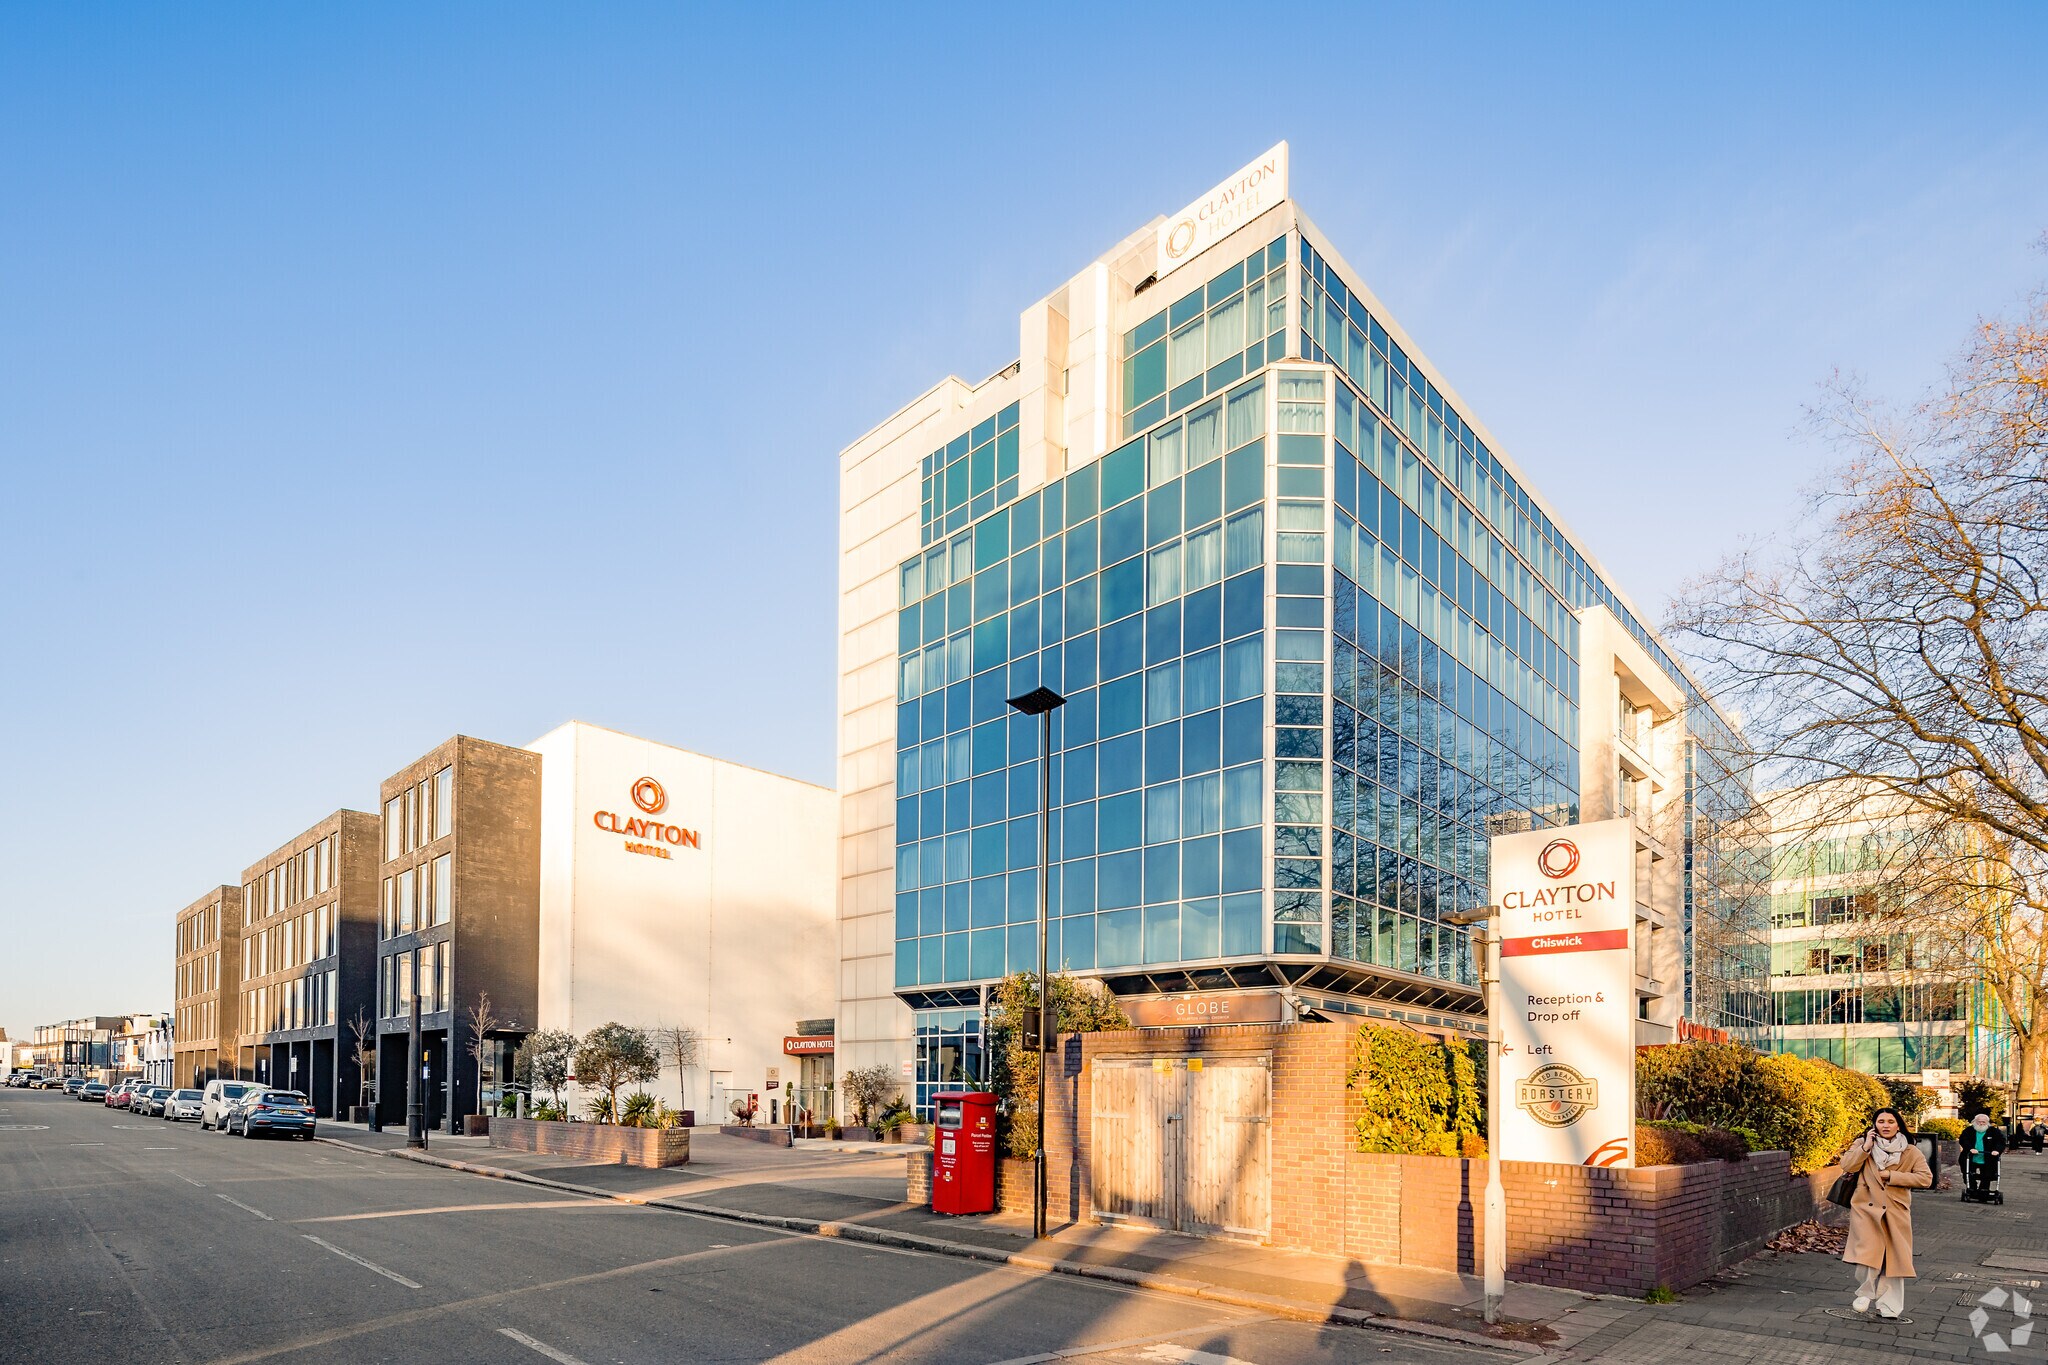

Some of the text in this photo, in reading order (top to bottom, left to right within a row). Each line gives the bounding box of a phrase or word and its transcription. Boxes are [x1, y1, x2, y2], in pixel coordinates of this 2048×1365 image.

[1198, 159, 1275, 221] CLAYTON
[1208, 191, 1262, 236] HOTEL
[593, 810, 698, 848] CLAYTON
[624, 840, 671, 859] HOTEL
[1502, 881, 1615, 910] CLAYTON
[1533, 909, 1582, 922] HOTEL
[1531, 936, 1582, 949] Chiswick
[1527, 991, 1605, 1007] Reception &
[1176, 1001, 1230, 1015] GLOBE
[1527, 1010, 1580, 1023] Drop off
[793, 1040, 834, 1049] CLAYTON HOTEL
[1527, 1044, 1553, 1055] Left
[1537, 1071, 1574, 1083] RED BEAN
[1521, 1087, 1593, 1101] ROASTERY
[1534, 1105, 1578, 1120] HAND CRAFTED
